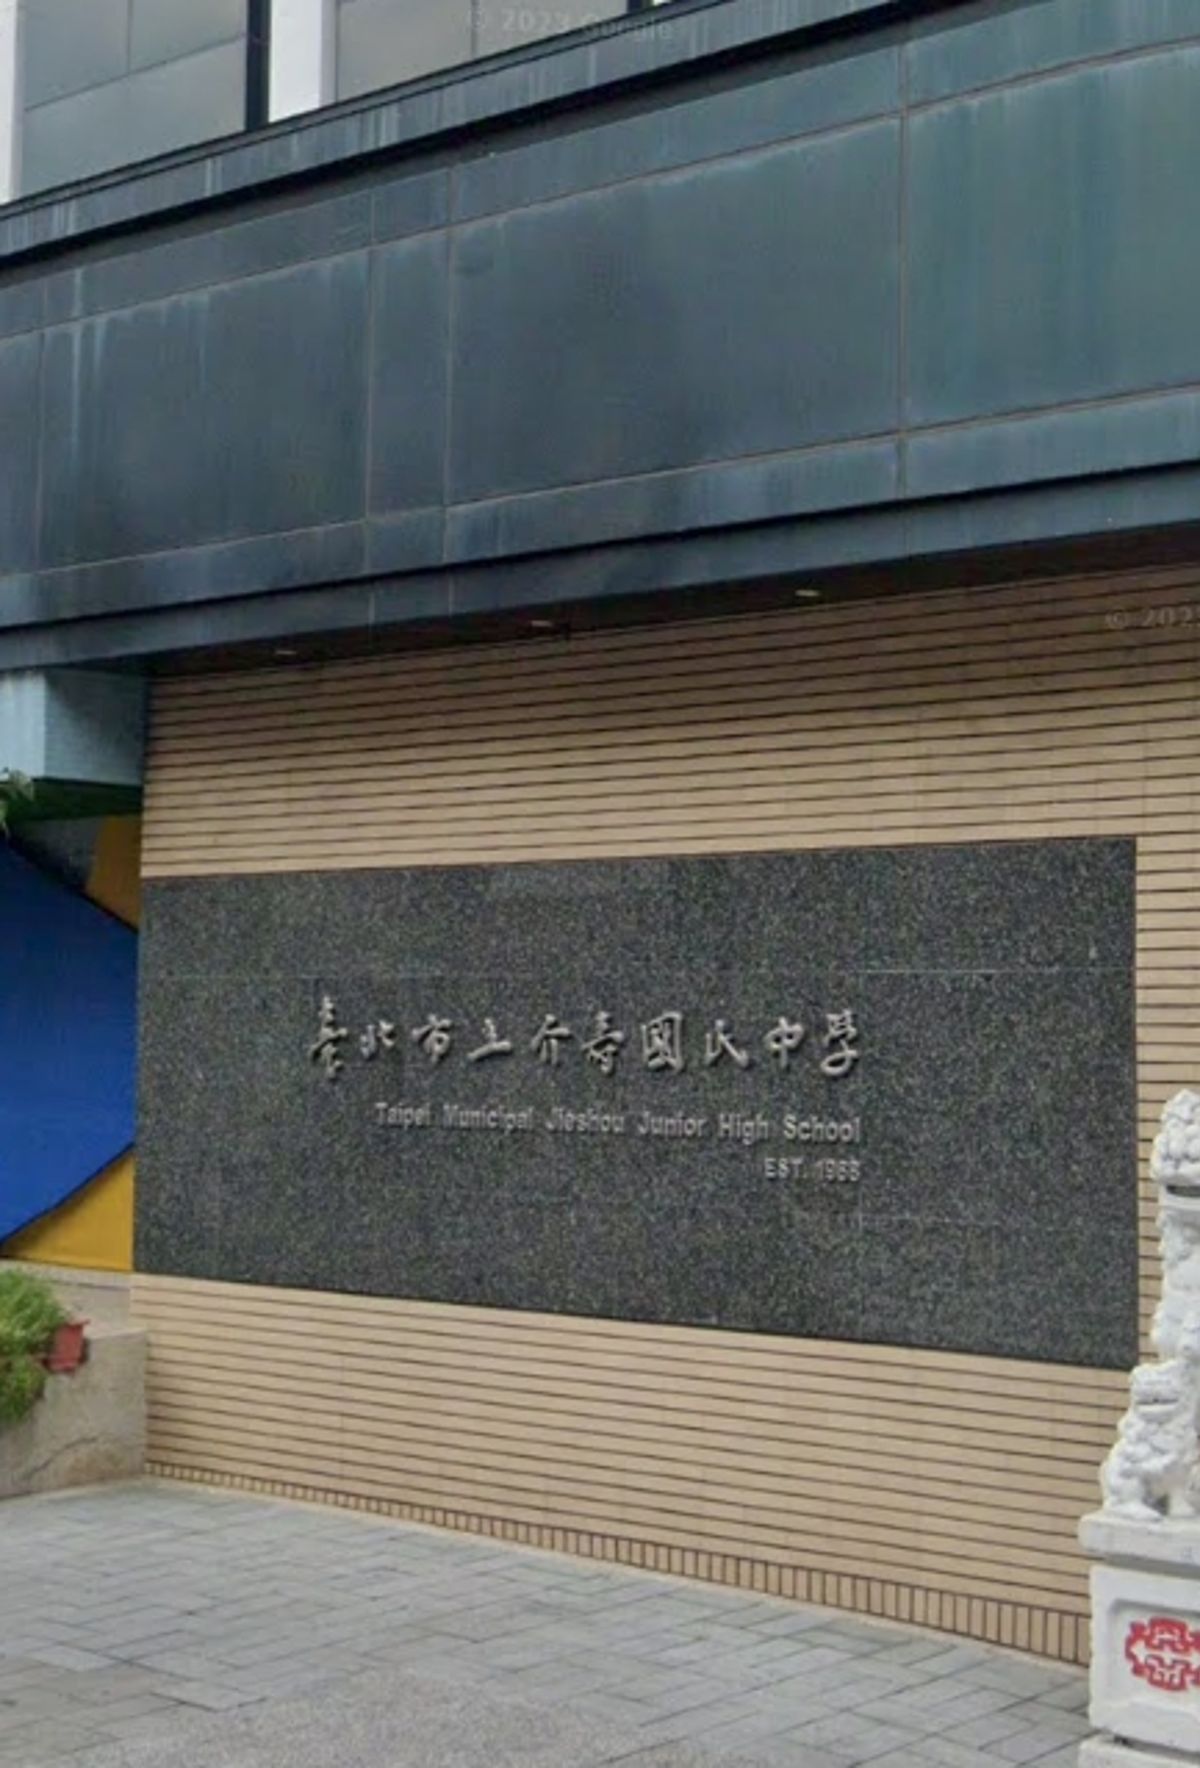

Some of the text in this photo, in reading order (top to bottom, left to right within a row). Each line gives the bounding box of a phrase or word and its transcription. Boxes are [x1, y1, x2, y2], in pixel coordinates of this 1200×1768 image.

[375, 1101, 431, 1130] Taipei
[443, 1102, 534, 1134] Municipal
[638, 1111, 705, 1137] Junior
[718, 1112, 769, 1146] High
[783, 1114, 861, 1142] School
